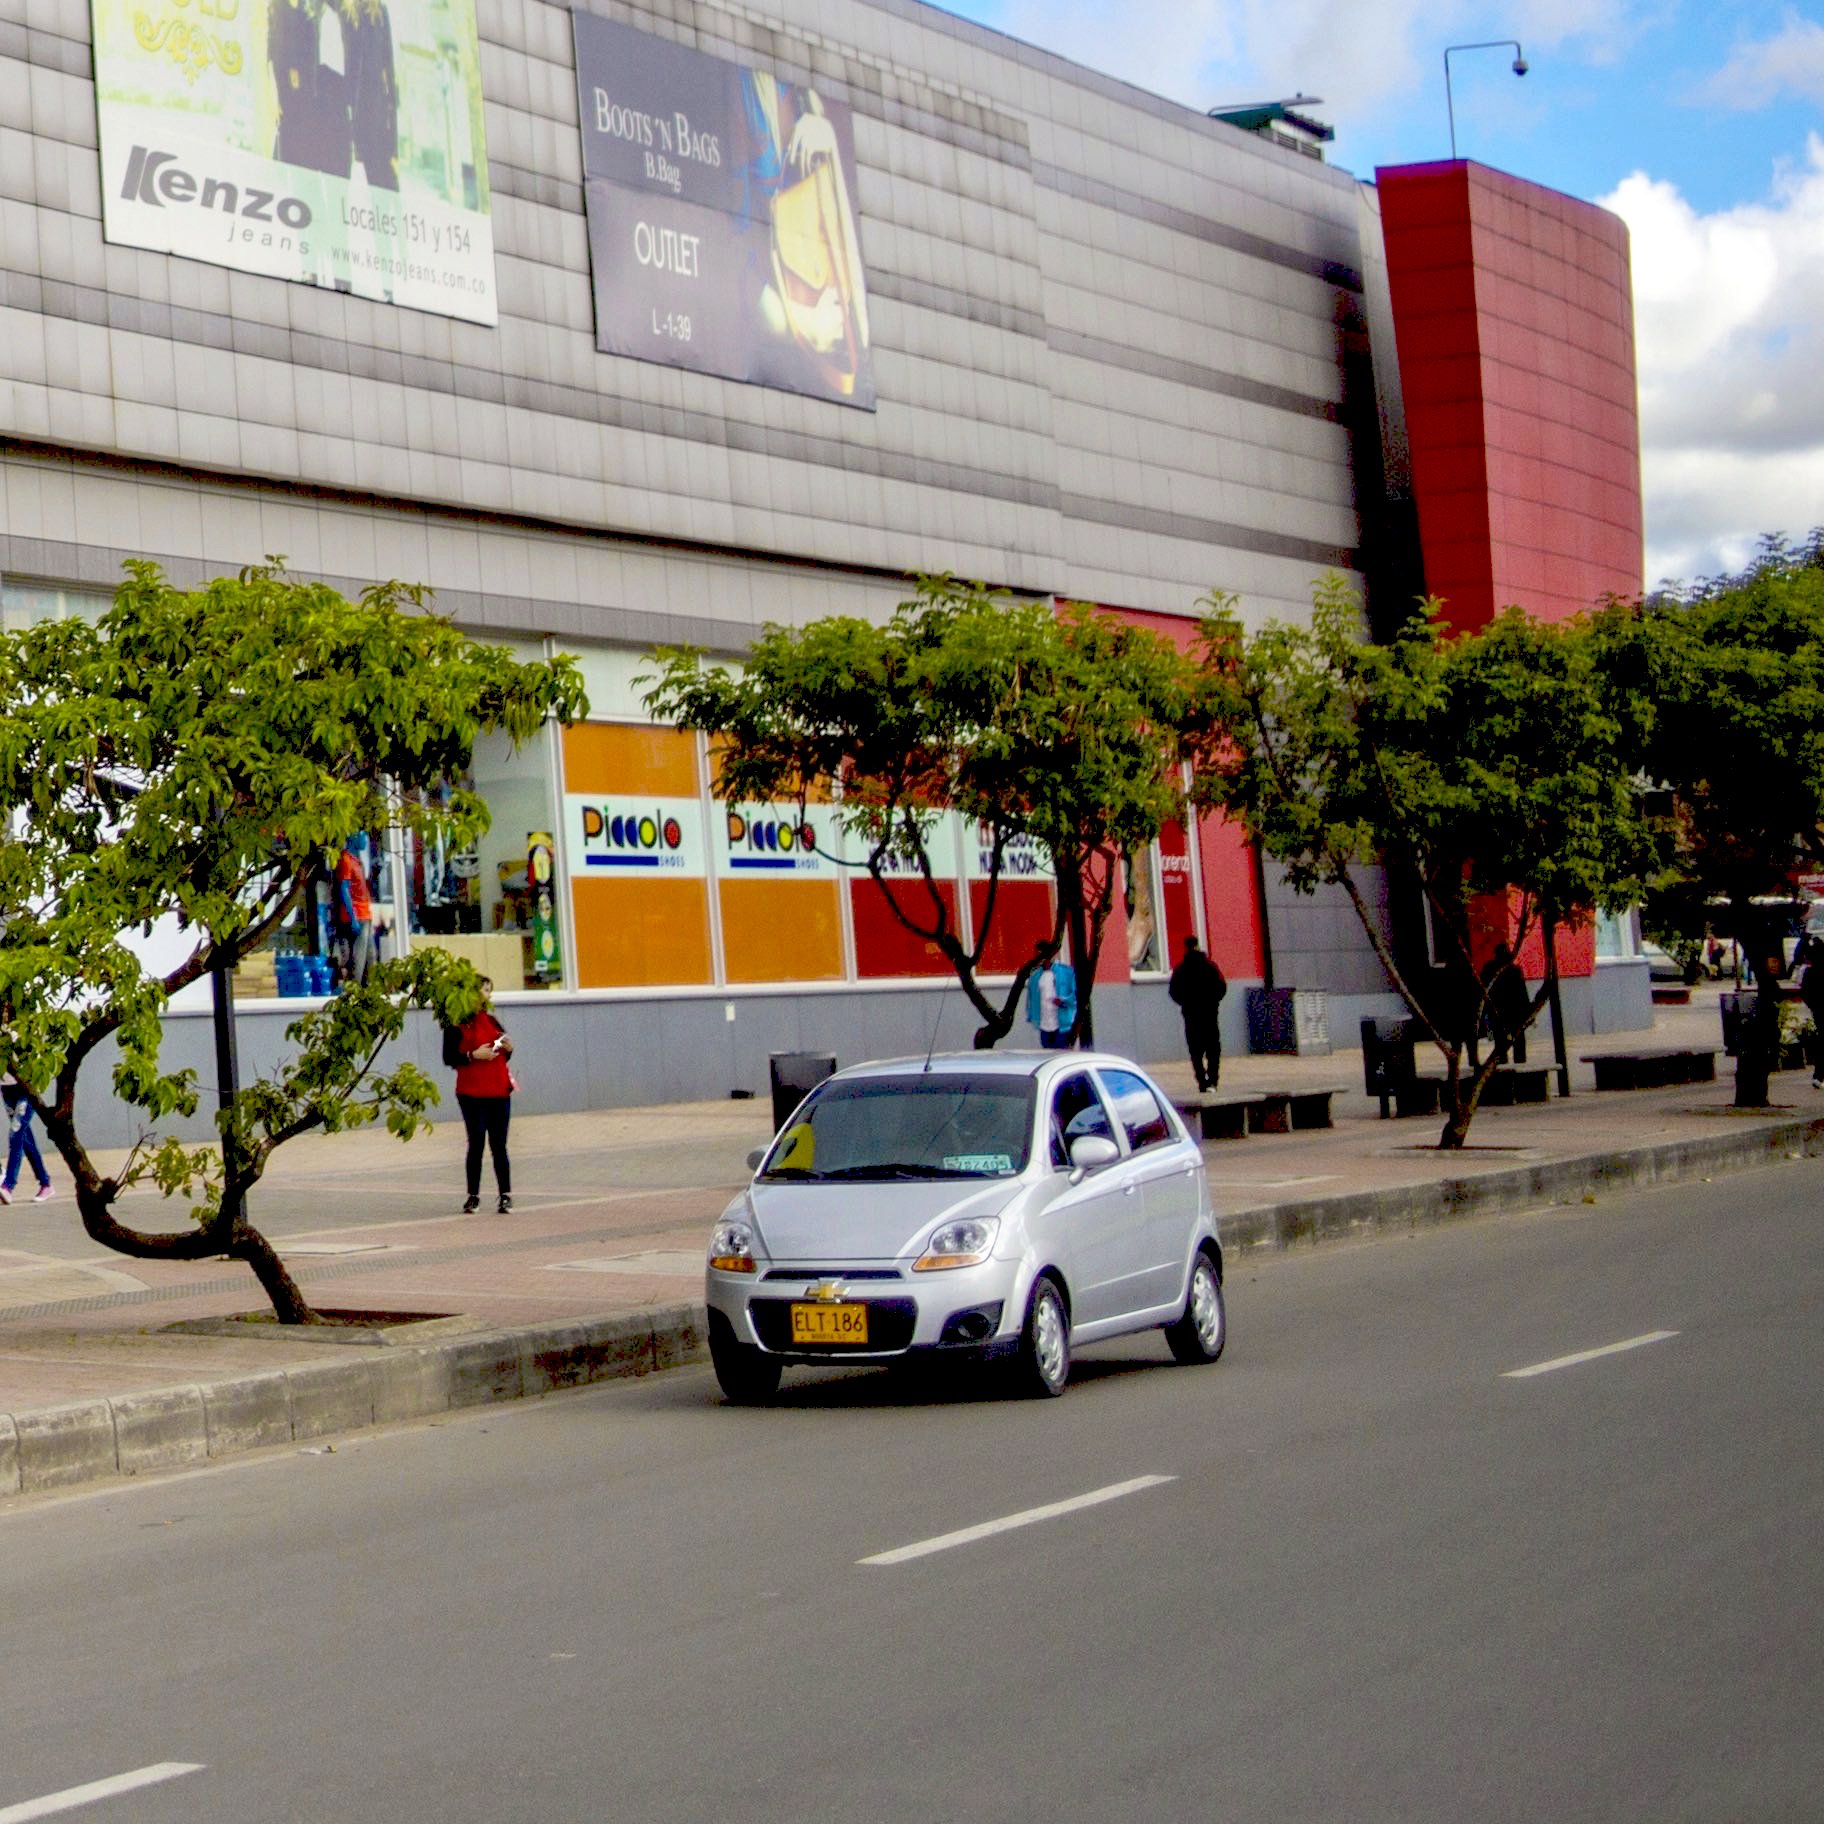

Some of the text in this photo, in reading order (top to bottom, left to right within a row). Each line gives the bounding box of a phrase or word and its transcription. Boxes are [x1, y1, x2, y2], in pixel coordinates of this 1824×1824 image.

[120, 145, 313, 230] Kenzo
[227, 220, 311, 256] jeans
[341, 197, 472, 254] Locales 151 y 154
[635, 221, 700, 278] OUTLET
[330, 245, 487, 295] www.kenzojeans.com.co
[582, 805, 682, 850] Piccolo
[727, 810, 816, 853] Piccolo
